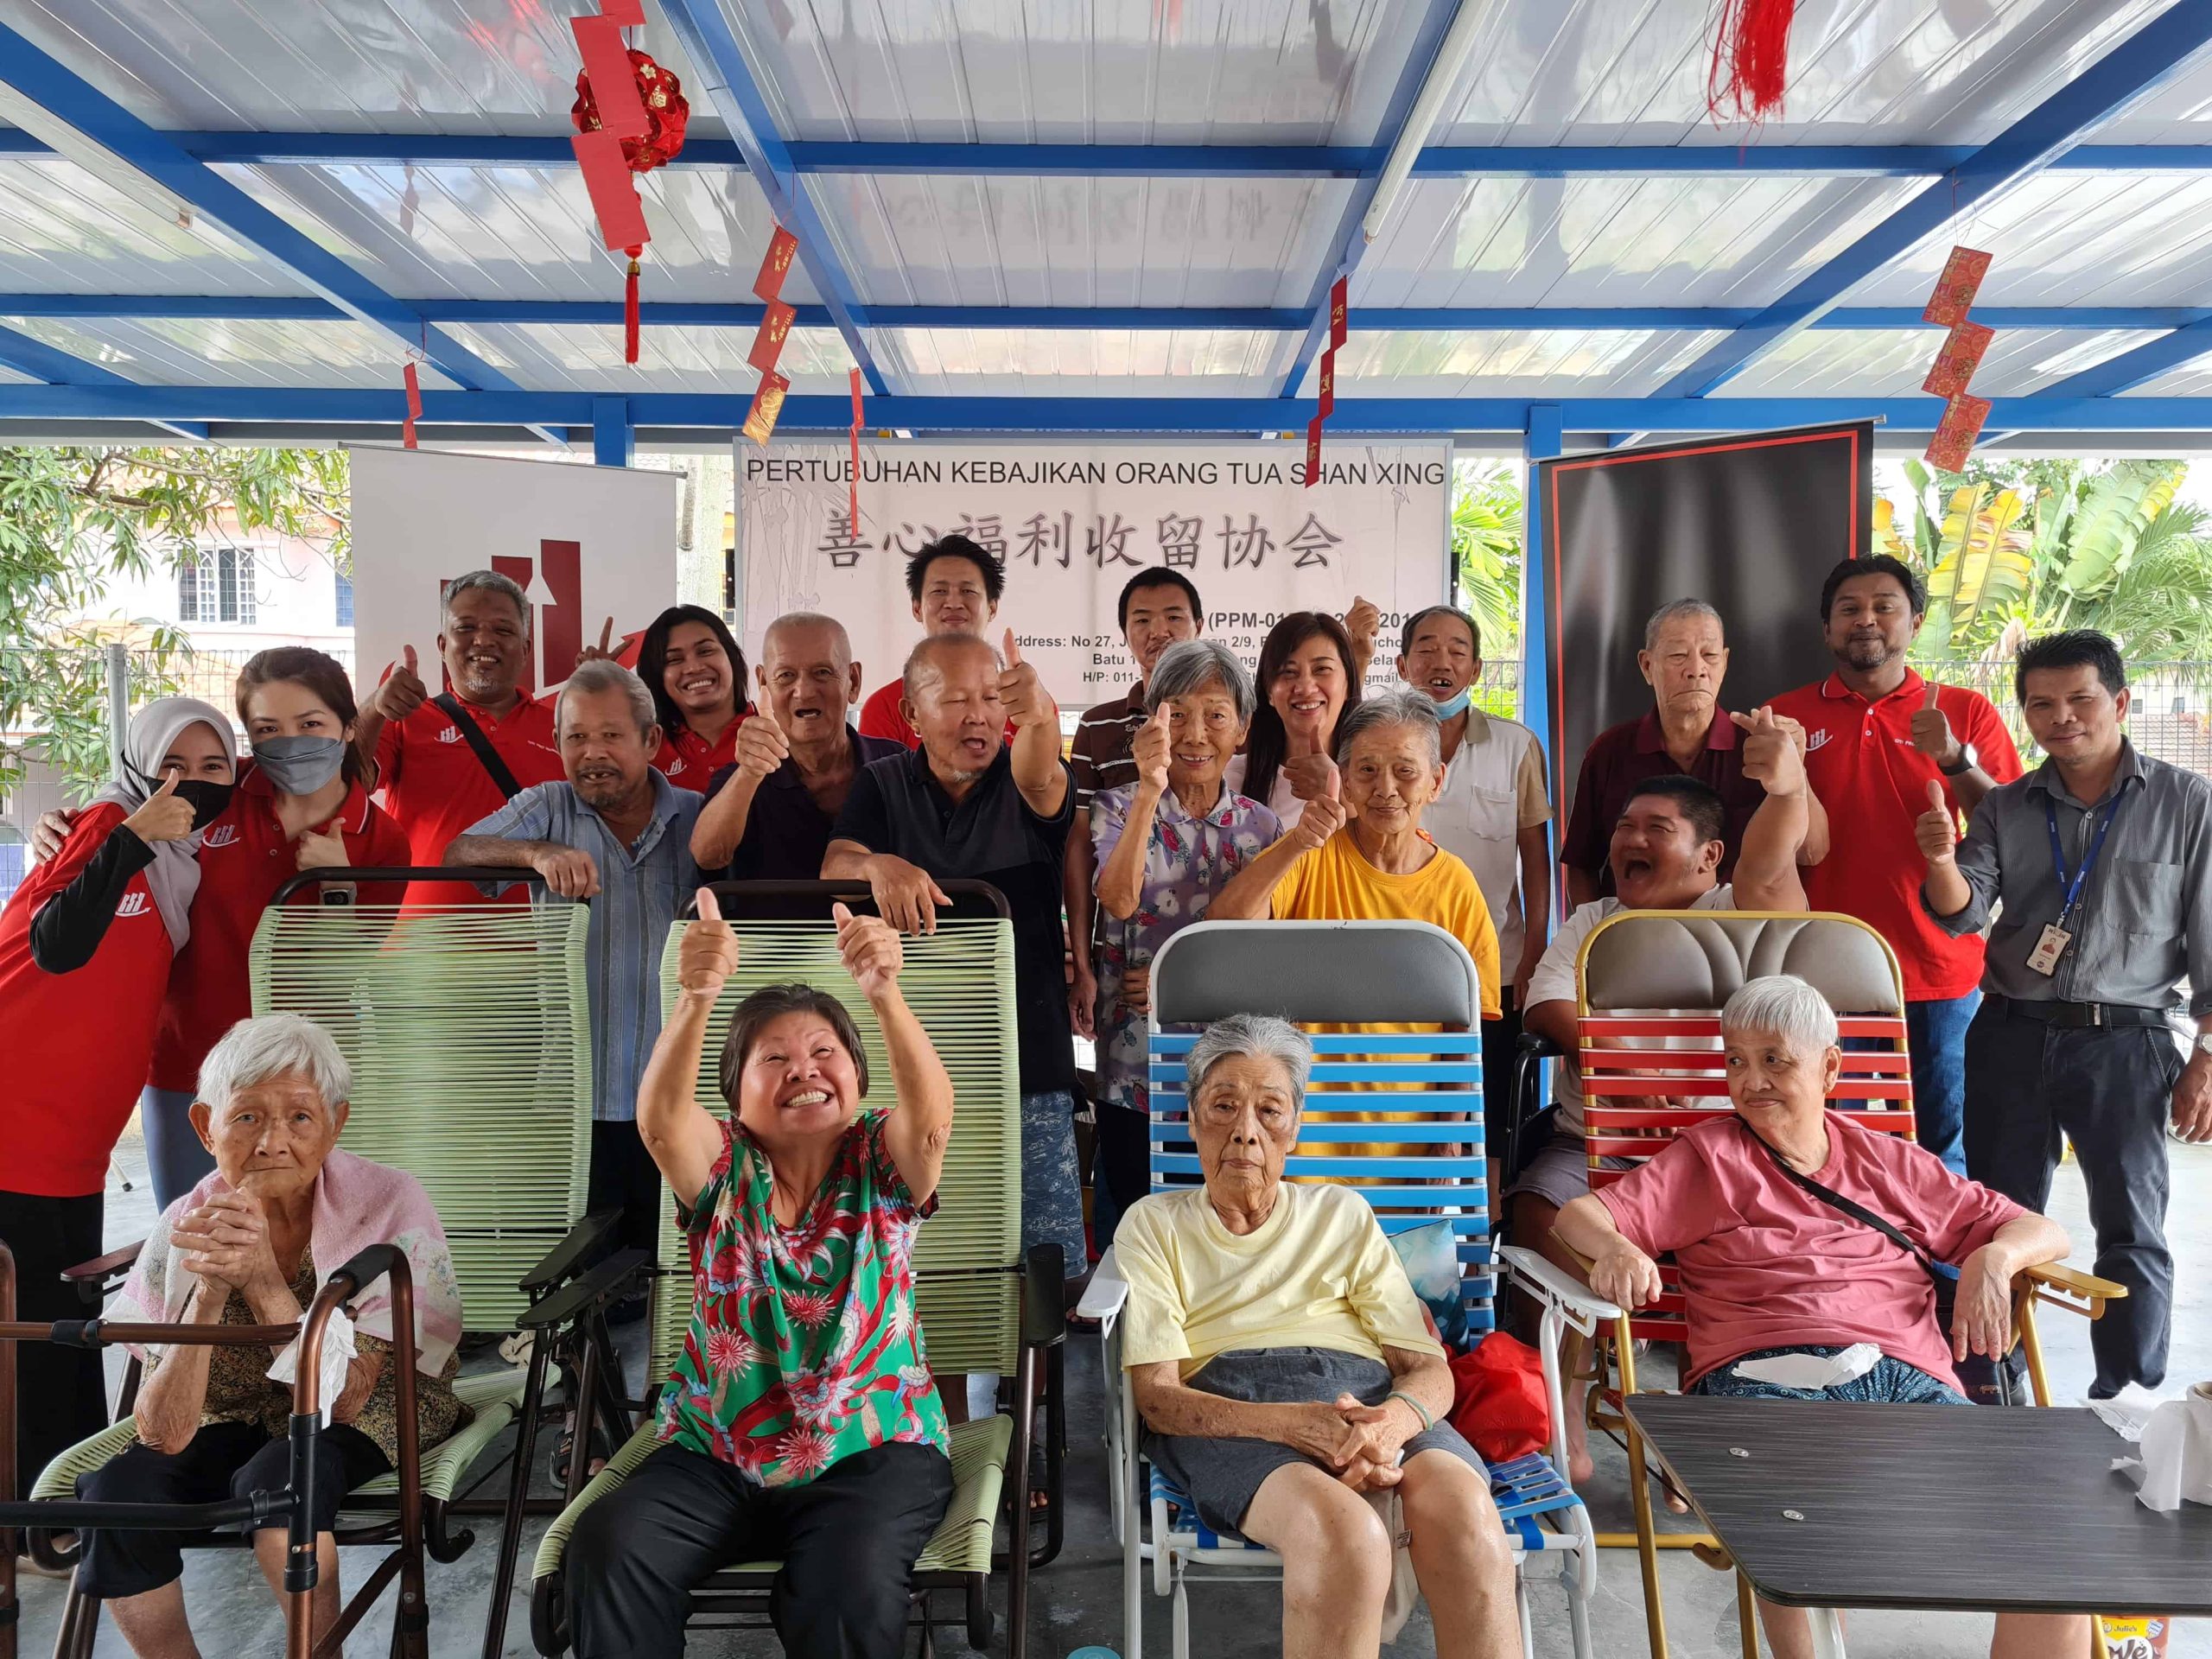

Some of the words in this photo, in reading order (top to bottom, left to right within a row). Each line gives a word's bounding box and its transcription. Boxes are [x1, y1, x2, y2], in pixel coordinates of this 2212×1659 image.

[747, 459, 941, 483] PERTUBUHAN
[952, 461, 1105, 484] KEBAJIKAN
[1116, 462, 1218, 485] ORANG
[1226, 462, 1282, 485] TUA
[1376, 462, 1445, 485] XING
[817, 508, 1344, 570] 善心福利收留协会
[1014, 635, 1067, 647] ddress:
[1071, 635, 1090, 647] No
[1095, 635, 1115, 649] 27,
[1231, 636, 1255, 649] 2/9,
[1093, 653, 1125, 664] Batu
[1083, 671, 1109, 683] H/P:
[1113, 671, 1141, 683] 011-
[1364, 672, 1398, 686] gmail
